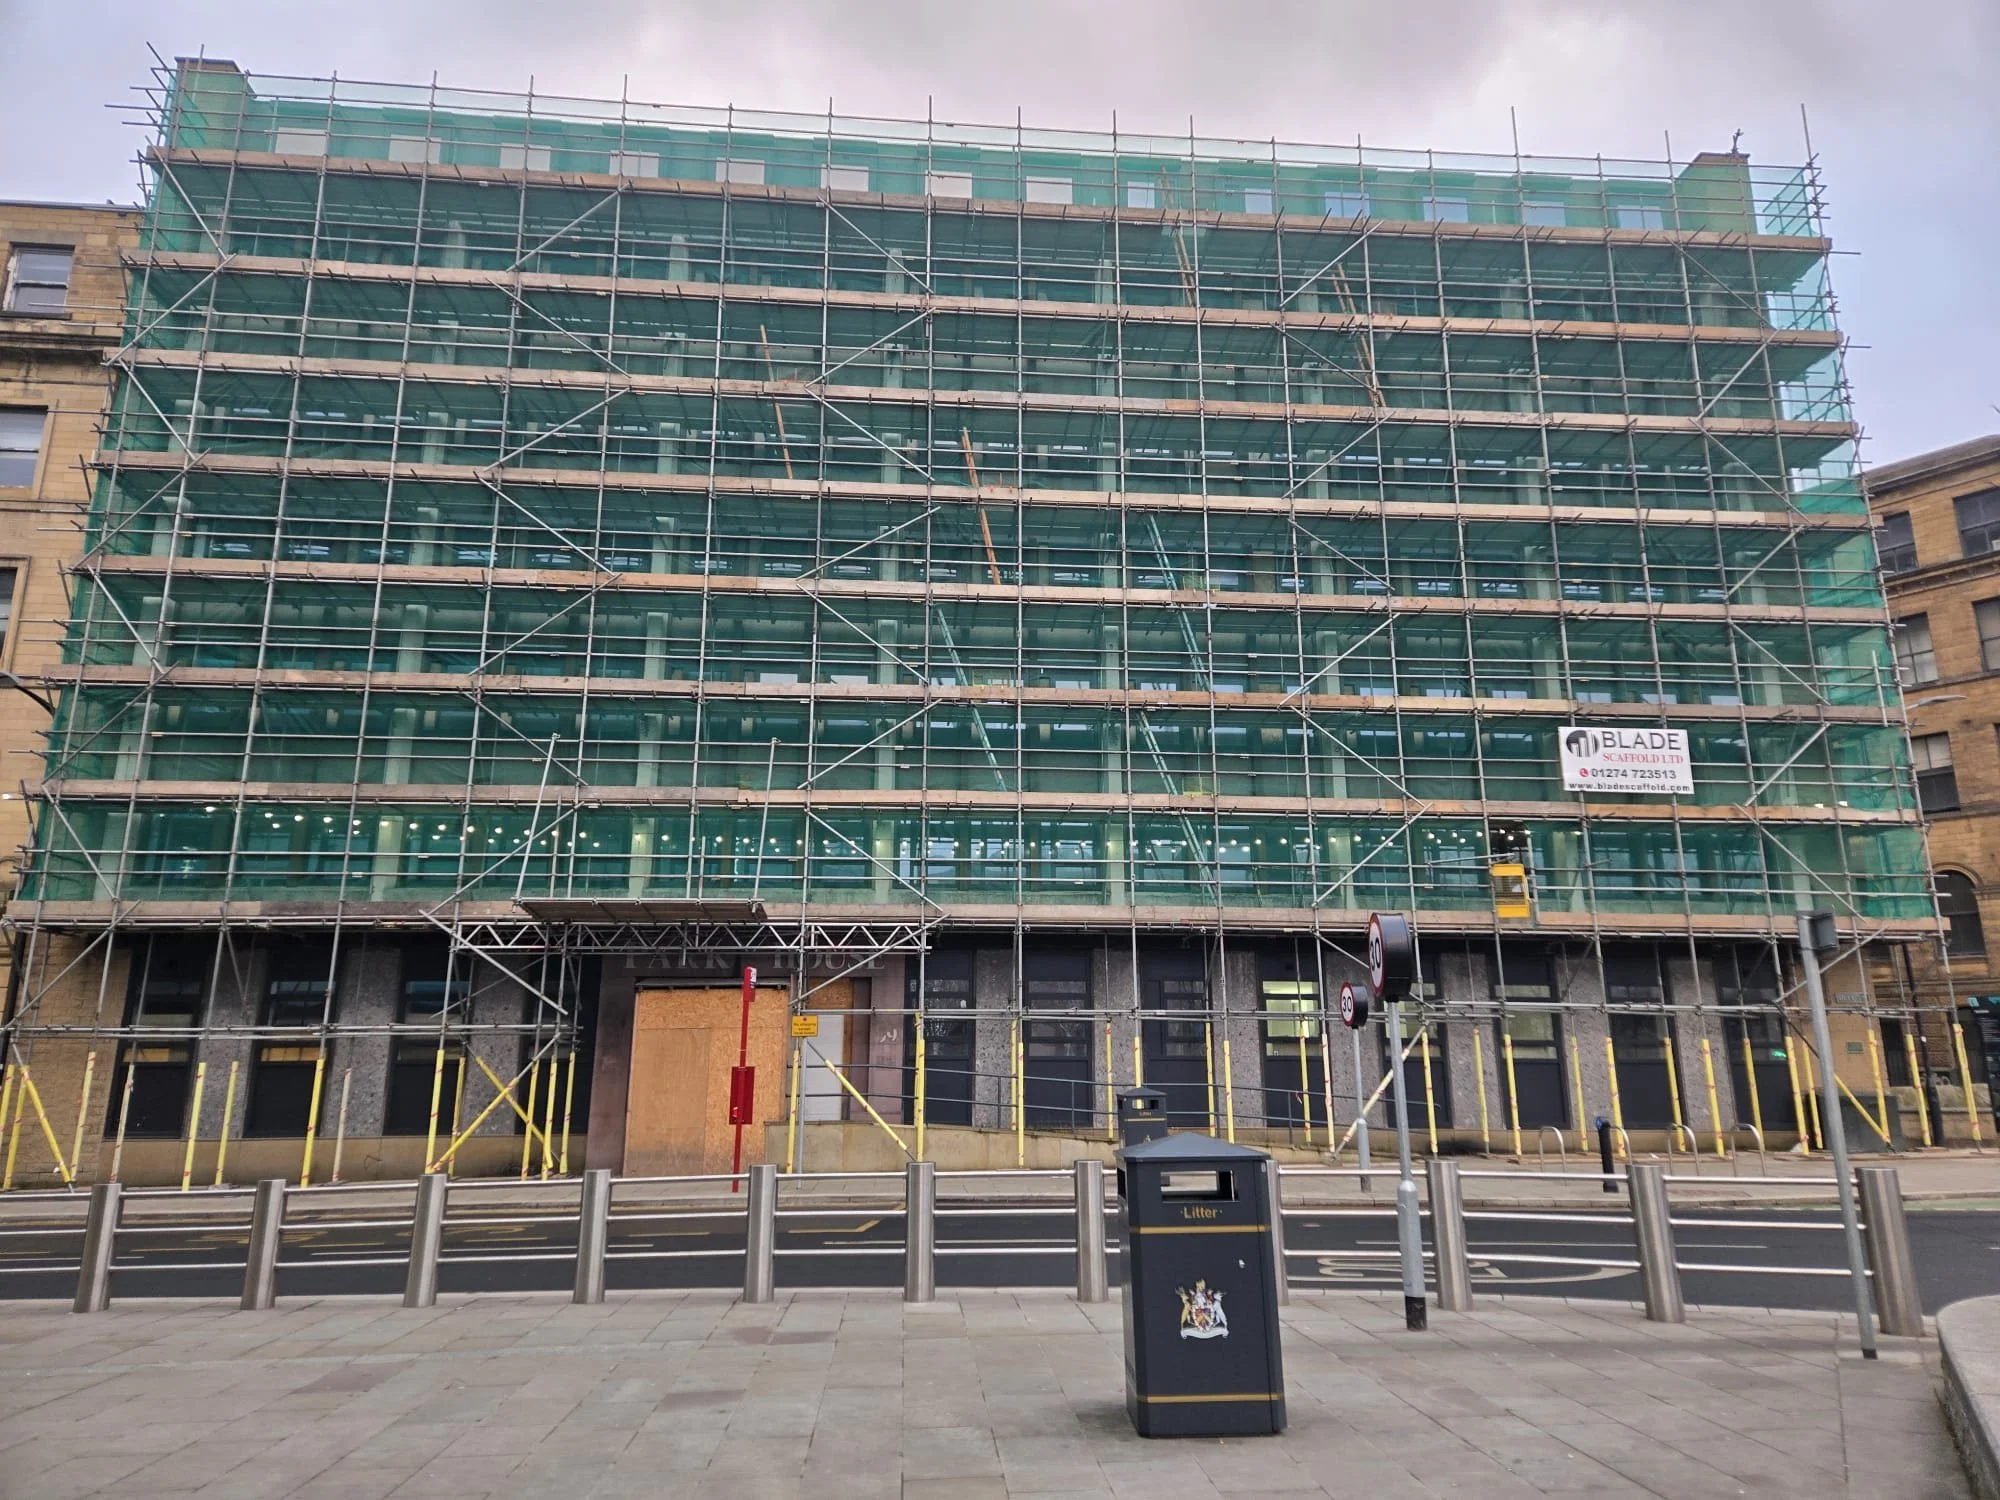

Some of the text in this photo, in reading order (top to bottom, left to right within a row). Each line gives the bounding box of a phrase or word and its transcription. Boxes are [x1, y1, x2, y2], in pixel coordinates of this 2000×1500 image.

[1601, 731, 1681, 750] BLADE
[1603, 753, 1684, 764] SCAFFOLD LTD
[1591, 768, 1677, 779] 01274 723513
[1569, 782, 1690, 791] www.bladescaffold.com
[1369, 937, 1381, 972] 30
[1342, 996, 1353, 1013] 30
[1183, 1205, 1218, 1219] Litter
